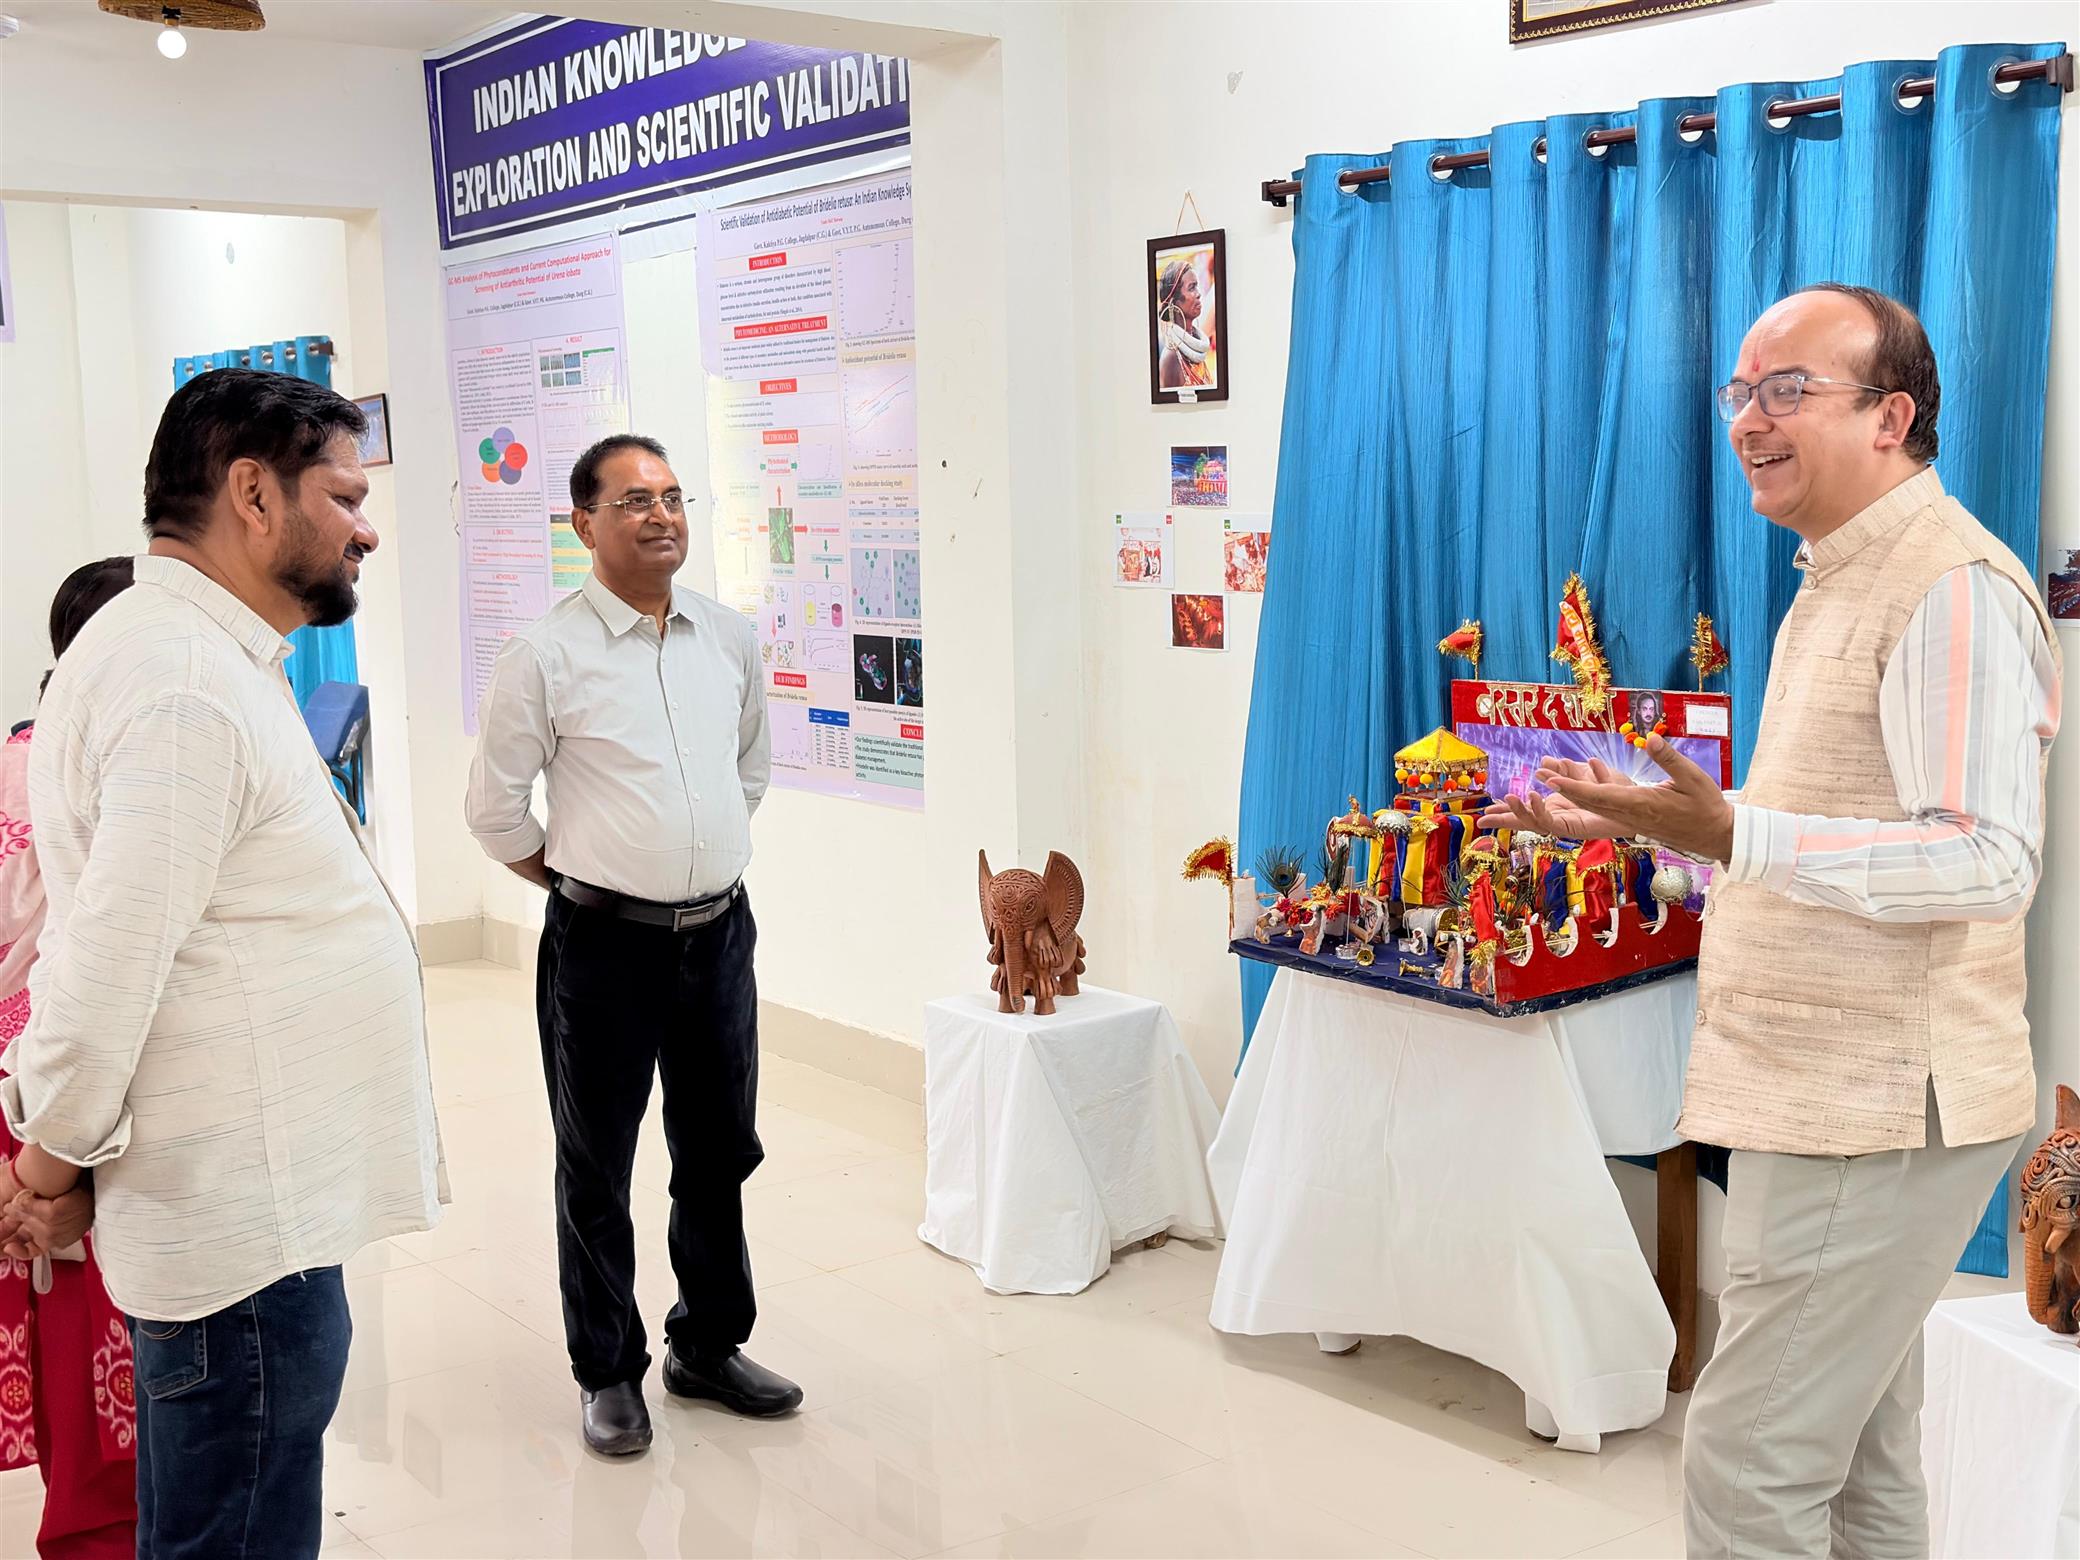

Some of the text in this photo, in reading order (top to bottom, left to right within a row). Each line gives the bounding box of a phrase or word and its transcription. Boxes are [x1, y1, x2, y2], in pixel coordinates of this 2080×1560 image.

[473, 27, 746, 134] INDIAN KNOWLED
[452, 53, 911, 217] EXPLORATION AND SCIENTIFIC VALIDATI
[720, 216, 739, 231] Scientific
[739, 212, 760, 227] Validation
[760, 210, 765, 224] of
[766, 205, 792, 222] Antidiabetic
[792, 200, 813, 216] Potential
[813, 199, 818, 213] of
[819, 196, 836, 212] Bridelia
[854, 192, 861, 205] An
[861, 189, 877, 203] Indian
[878, 183, 904, 201] Knowledge
[1476, 684, 1539, 727] बस्तर
